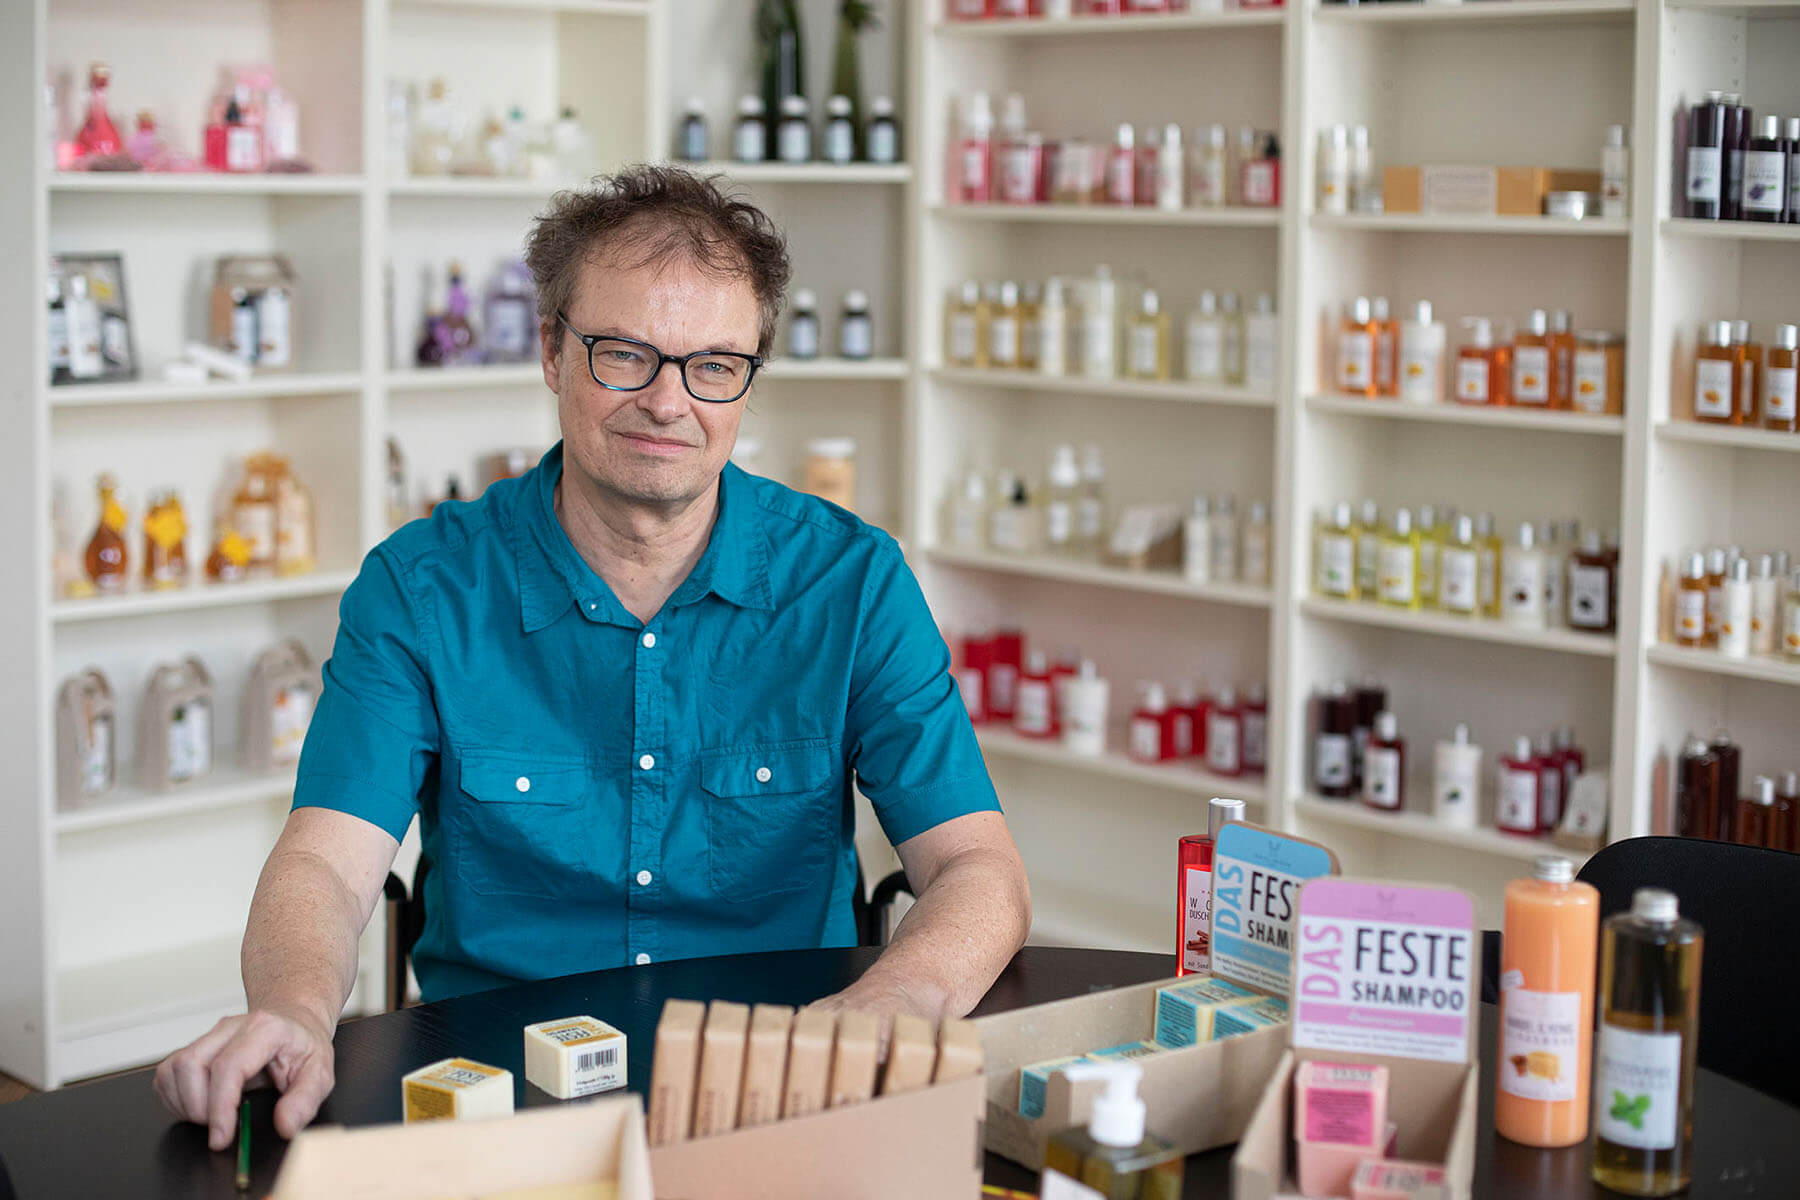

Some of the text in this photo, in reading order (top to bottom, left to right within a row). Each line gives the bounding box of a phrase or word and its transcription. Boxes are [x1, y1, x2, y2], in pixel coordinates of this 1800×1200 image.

[1214, 862, 1244, 934] DAS
[1250, 870, 1299, 922] FES
[1247, 920, 1293, 951] SHAM
[1300, 923, 1344, 999] DAS
[1354, 926, 1468, 981] FESTE
[1351, 980, 1465, 1011] SHAMPOO
